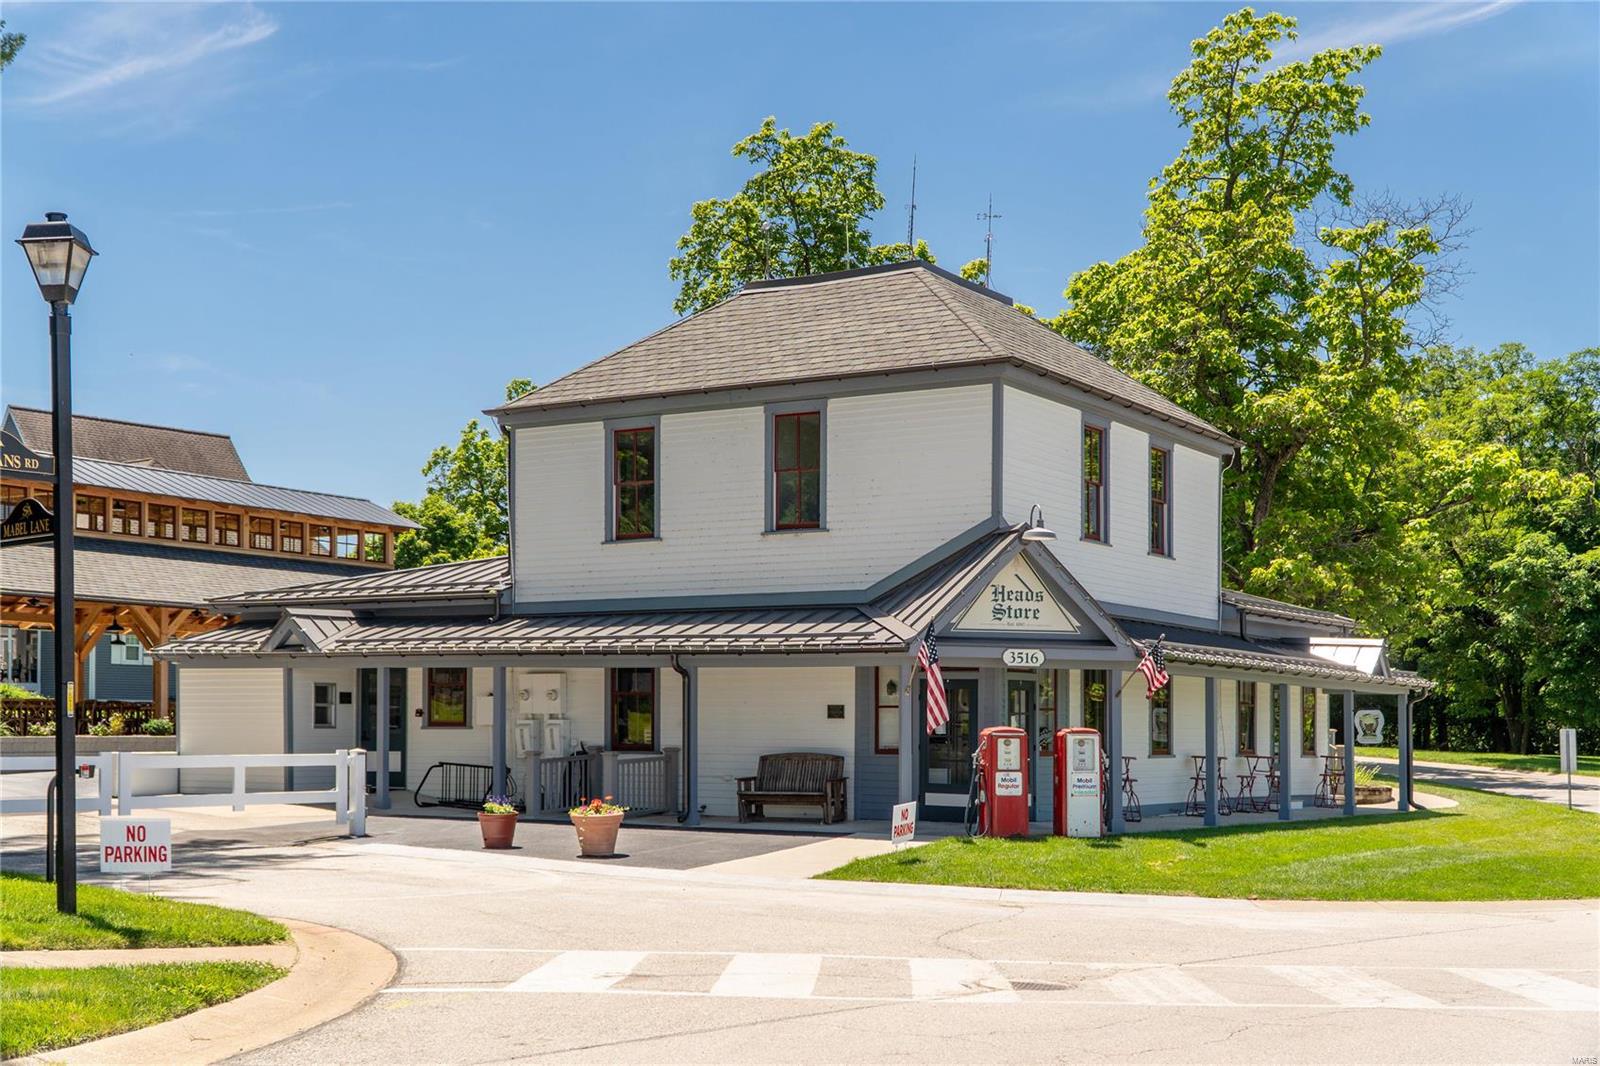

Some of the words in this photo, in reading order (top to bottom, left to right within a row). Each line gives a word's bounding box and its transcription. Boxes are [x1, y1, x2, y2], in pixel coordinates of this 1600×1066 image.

[23, 457, 39, 469] RD
[3, 520, 28, 538] MABEL
[30, 518, 50, 534] LANE
[990, 574, 1044, 602] Heads
[991, 603, 1041, 621] Store
[1009, 651, 1039, 664] 3516
[901, 808, 909, 821] NO
[126, 825, 146, 842] NO
[894, 821, 914, 839] PARKING
[104, 845, 168, 863] PARKING
